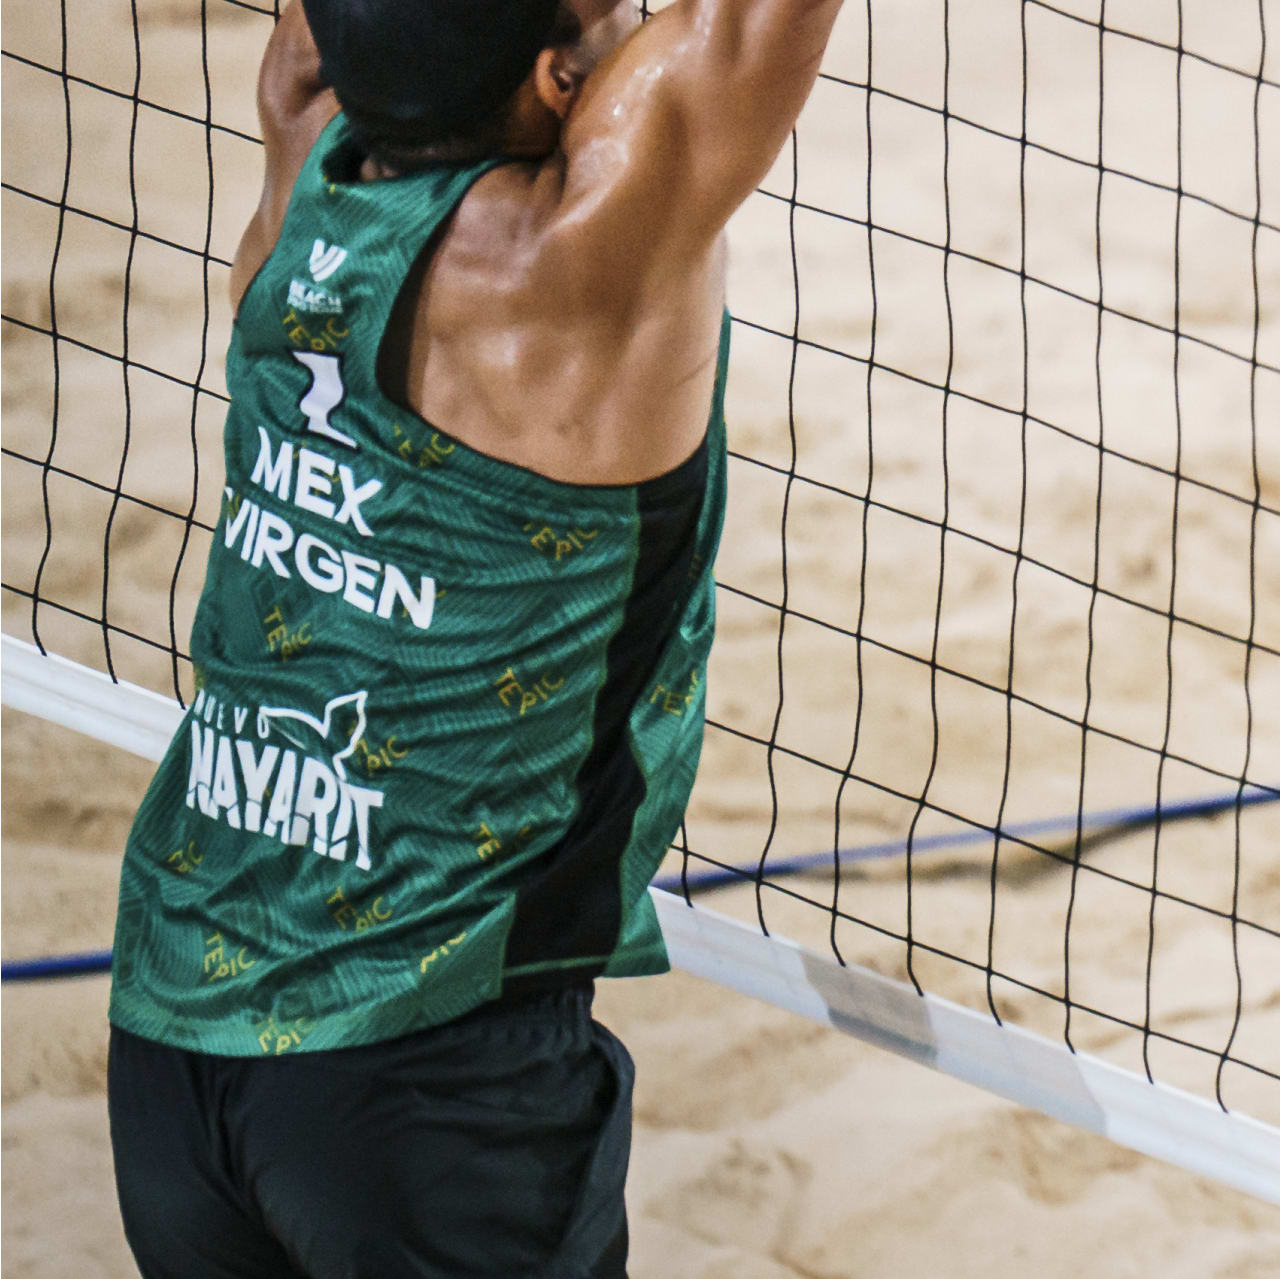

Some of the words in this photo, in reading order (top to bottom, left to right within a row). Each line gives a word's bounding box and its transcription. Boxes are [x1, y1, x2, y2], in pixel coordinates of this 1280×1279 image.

[250, 425, 384, 537] MEX
[224, 486, 436, 631] VIRGEN
[185, 719, 385, 872] NAYARIT
